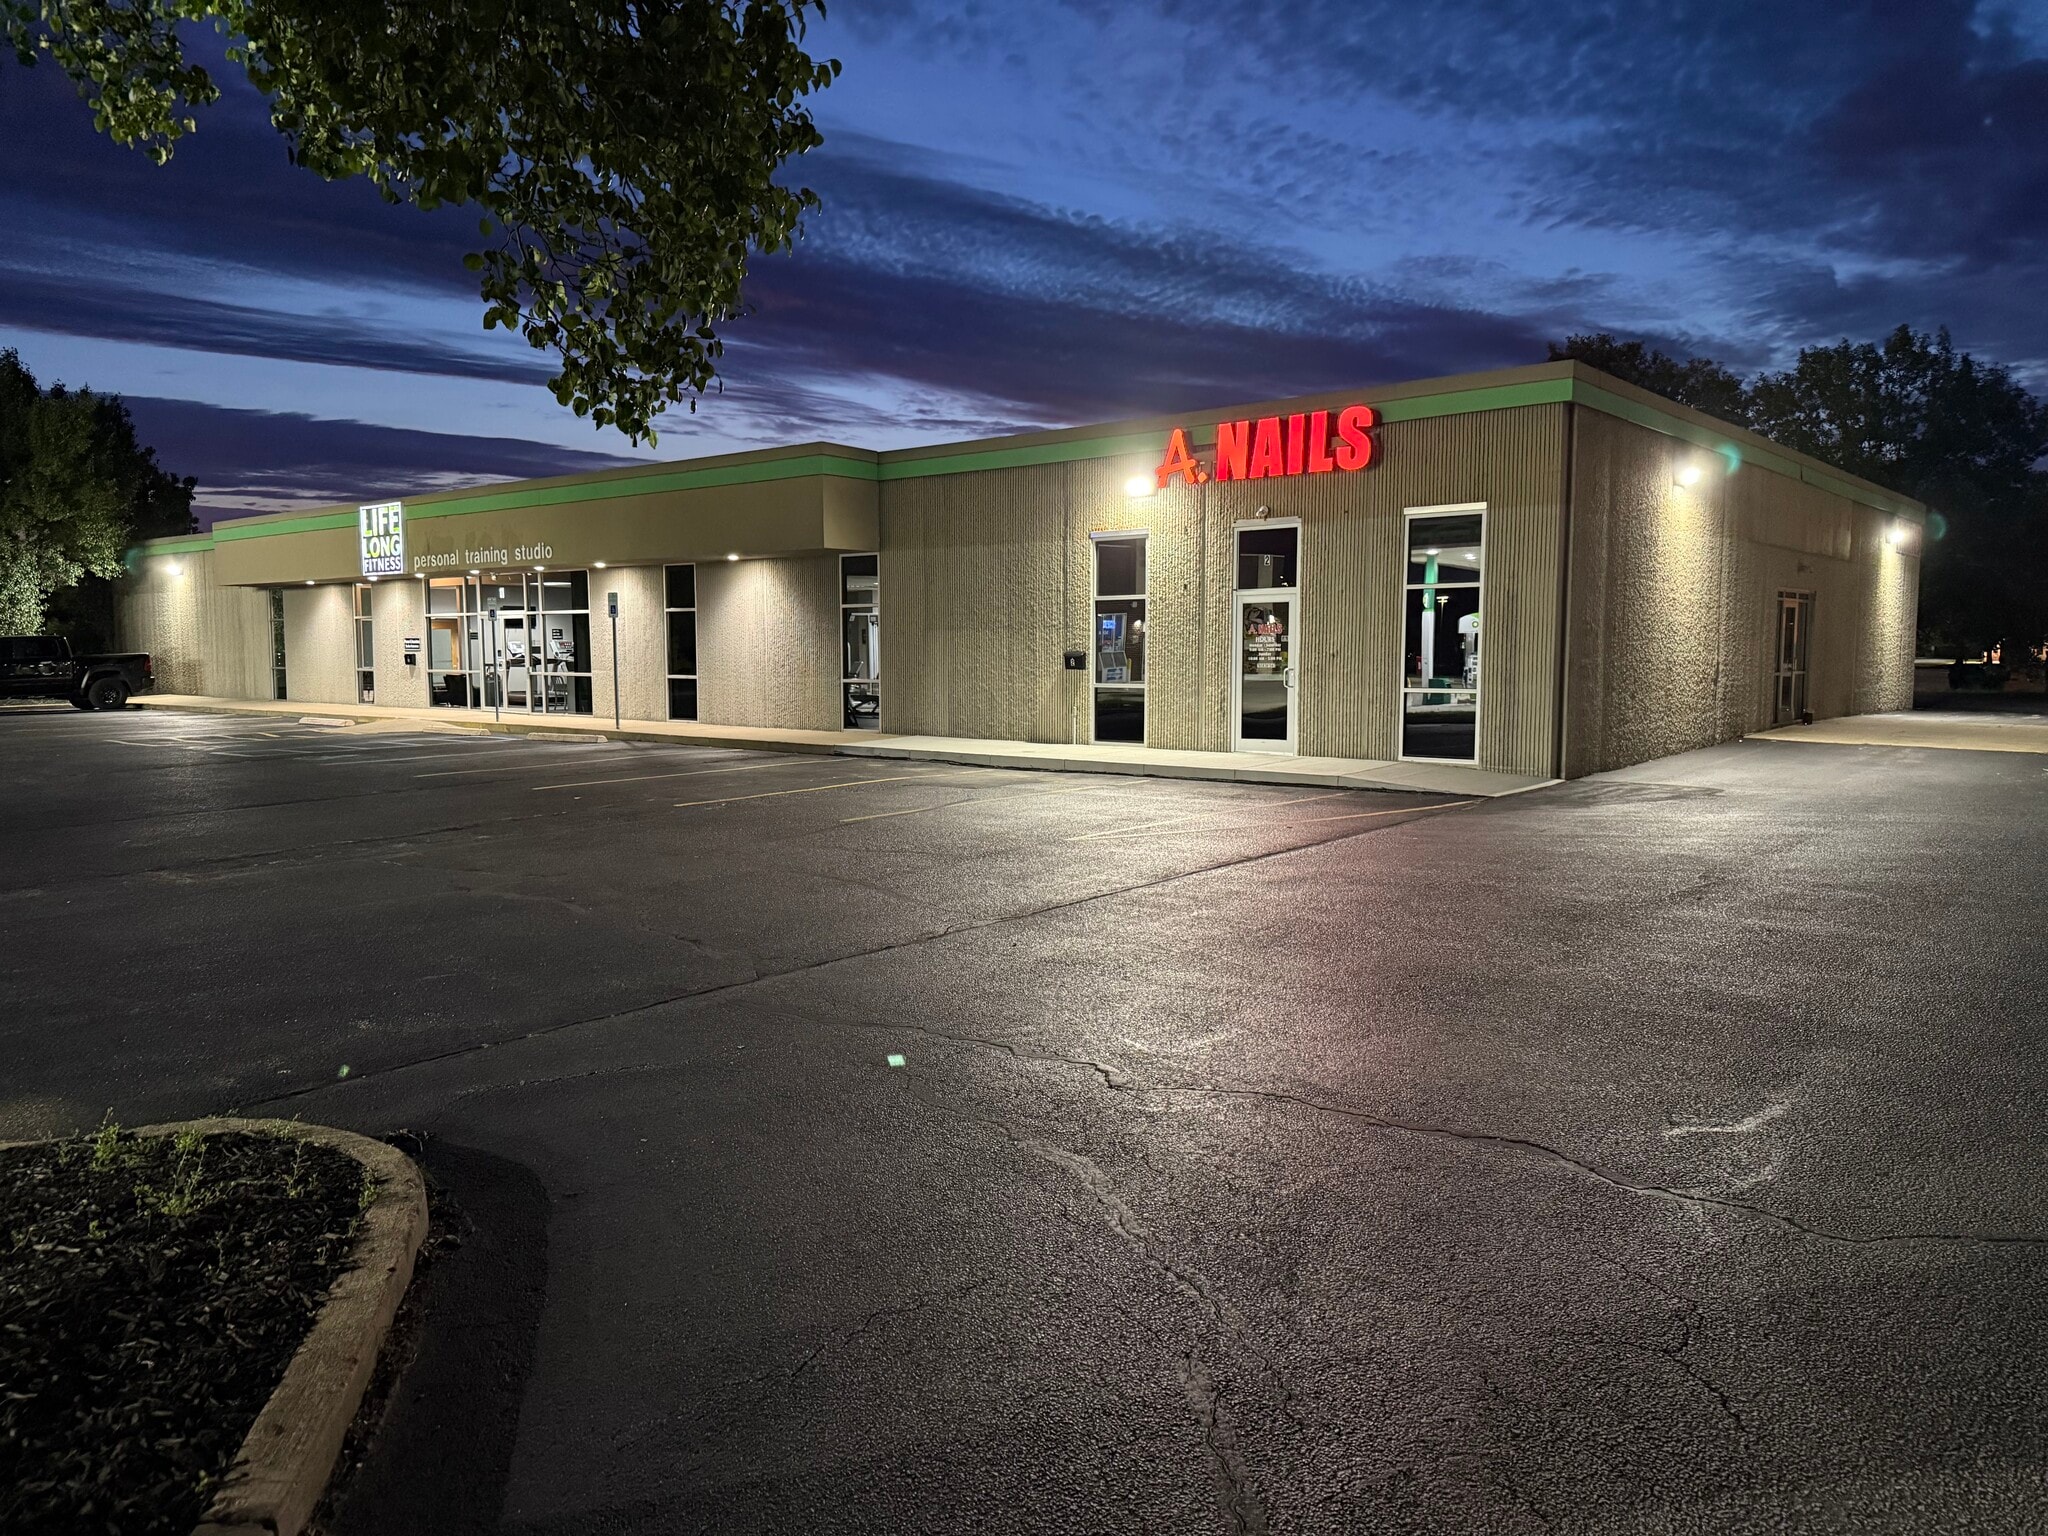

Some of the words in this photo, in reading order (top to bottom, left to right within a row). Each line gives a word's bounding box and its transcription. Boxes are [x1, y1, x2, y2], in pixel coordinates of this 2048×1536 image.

[1155, 428, 1208, 489] A.
[1215, 405, 1374, 482] NAILS
[361, 505, 400, 537] LIFE
[363, 535, 401, 558] LONG
[414, 549, 459, 571] personal
[465, 546, 508, 565] training
[514, 542, 553, 560] studio
[364, 556, 401, 572] FITNESS
